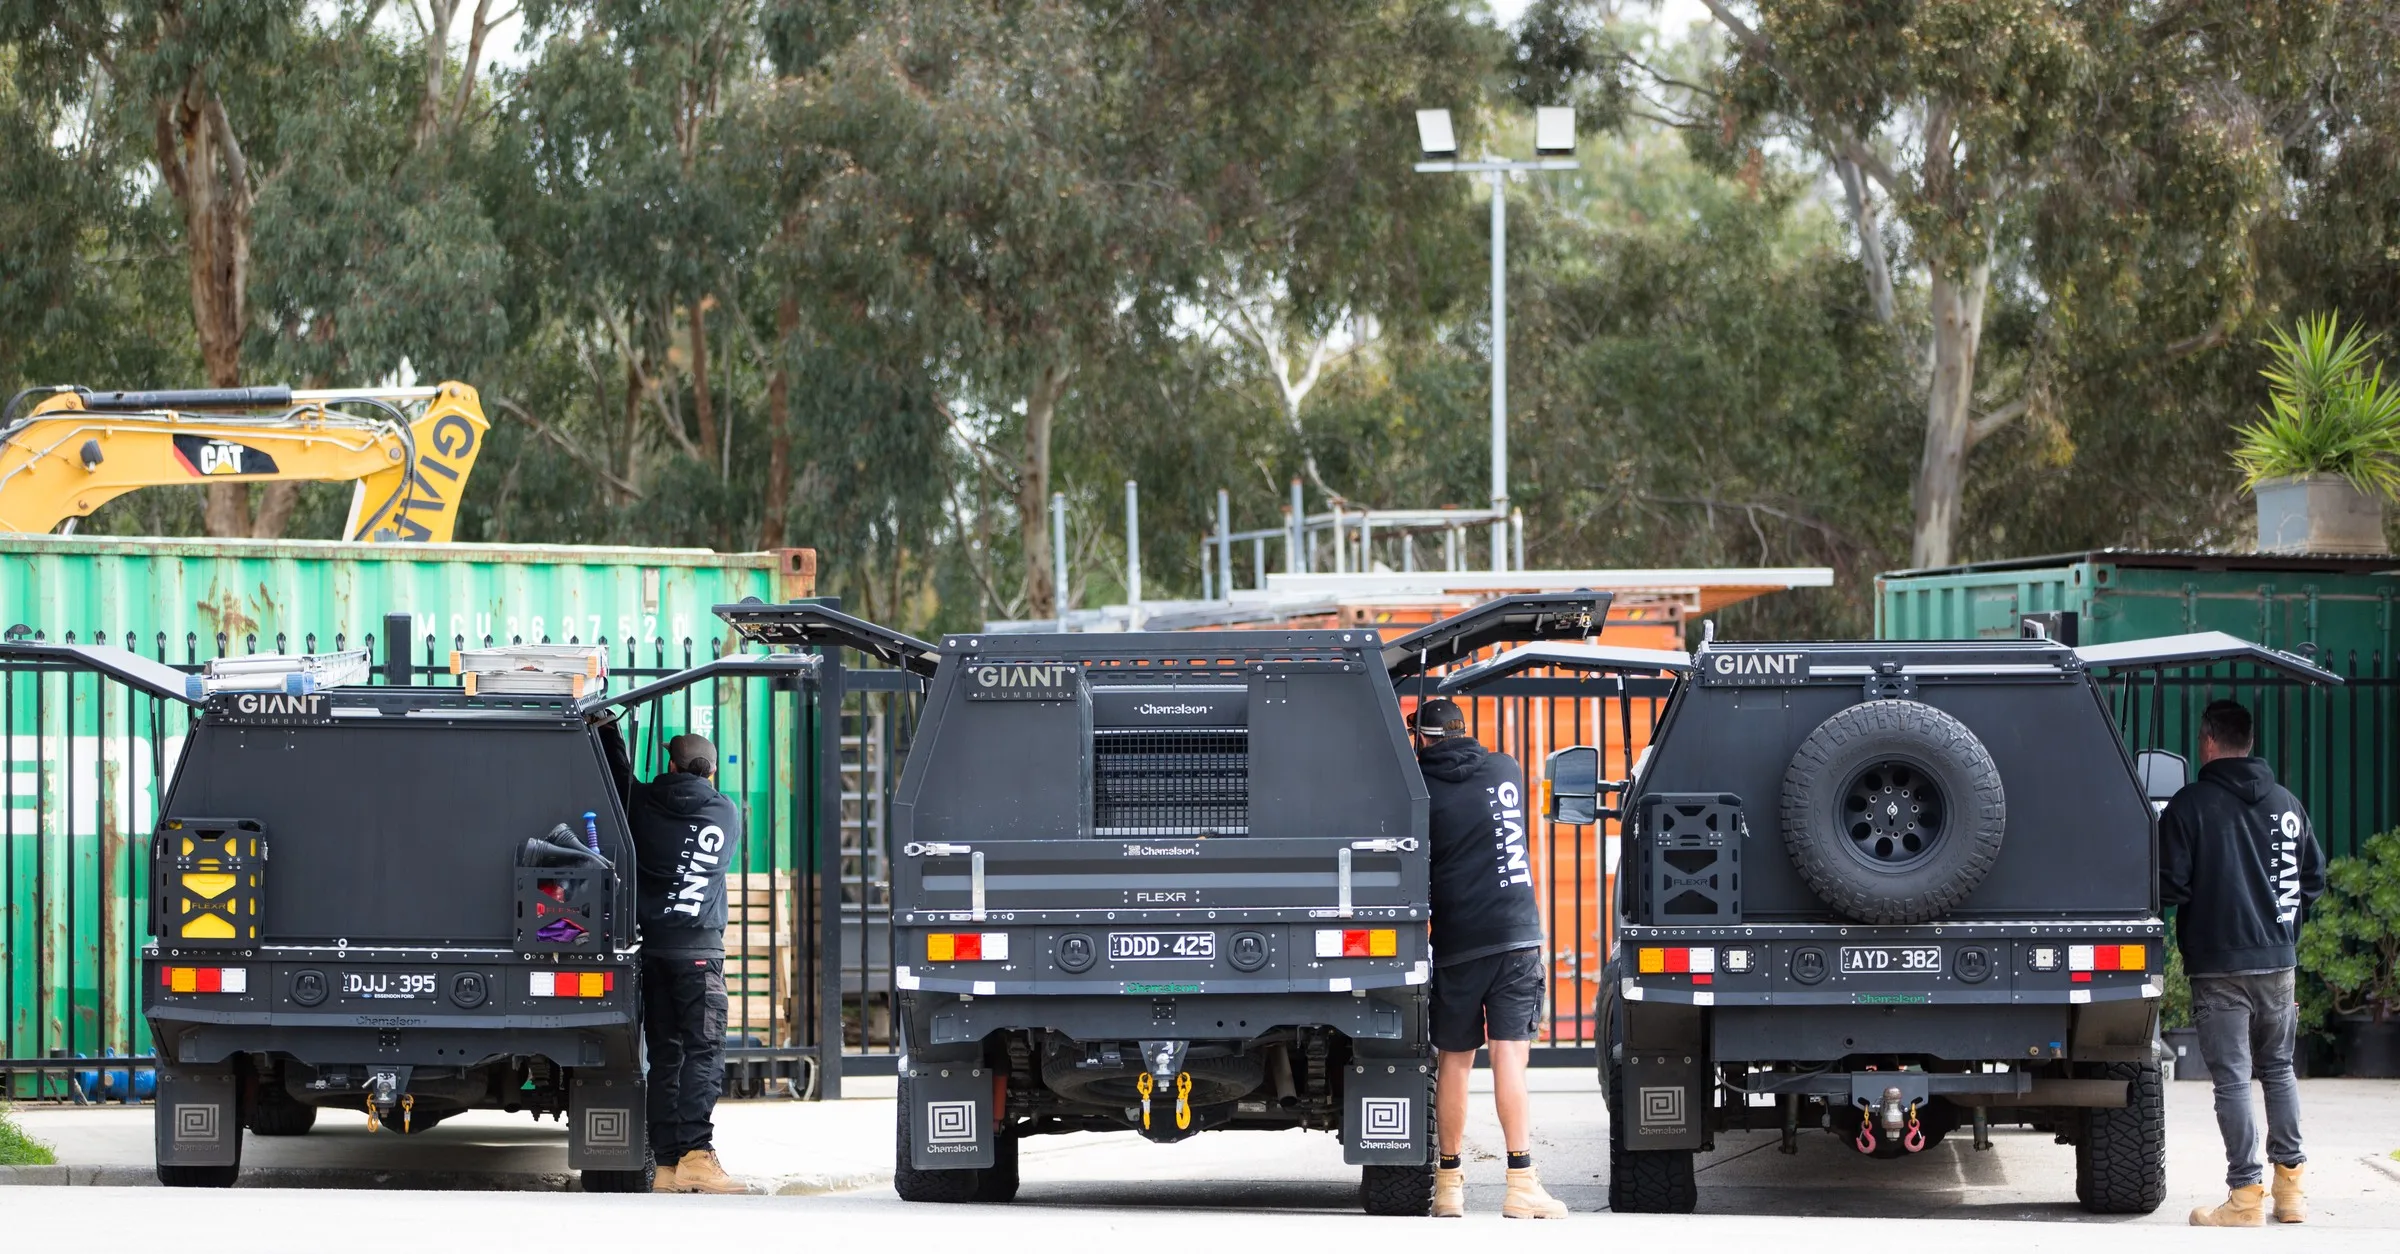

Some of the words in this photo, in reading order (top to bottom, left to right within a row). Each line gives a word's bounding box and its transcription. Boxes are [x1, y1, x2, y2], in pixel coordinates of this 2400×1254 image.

[200, 445, 244, 474] CAT
[1715, 654, 1799, 675] GIANT
[977, 666, 1066, 687] GIANT
[238, 694, 321, 714] GIANT
[1140, 703, 1207, 714] Chameleon
[1486, 786, 1509, 888] PLUMBING
[1497, 781, 1531, 887] GIANT
[1141, 846, 1195, 856] Chameleon
[664, 825, 698, 914] PLUMING
[673, 825, 725, 917] GIANT
[2279, 811, 2300, 925] GIANT
[1137, 892, 1187, 902] FLEXR
[1127, 982, 1199, 993] Chameleon
[1858, 993, 1925, 1004] Chameleon
[355, 1015, 421, 1026] Chameleon
[1638, 1126, 1687, 1135] Chameleon
[927, 1144, 978, 1153] Chameleon
[1360, 1140, 1411, 1149] Chameleon
[583, 1147, 630, 1155] Chameleon
